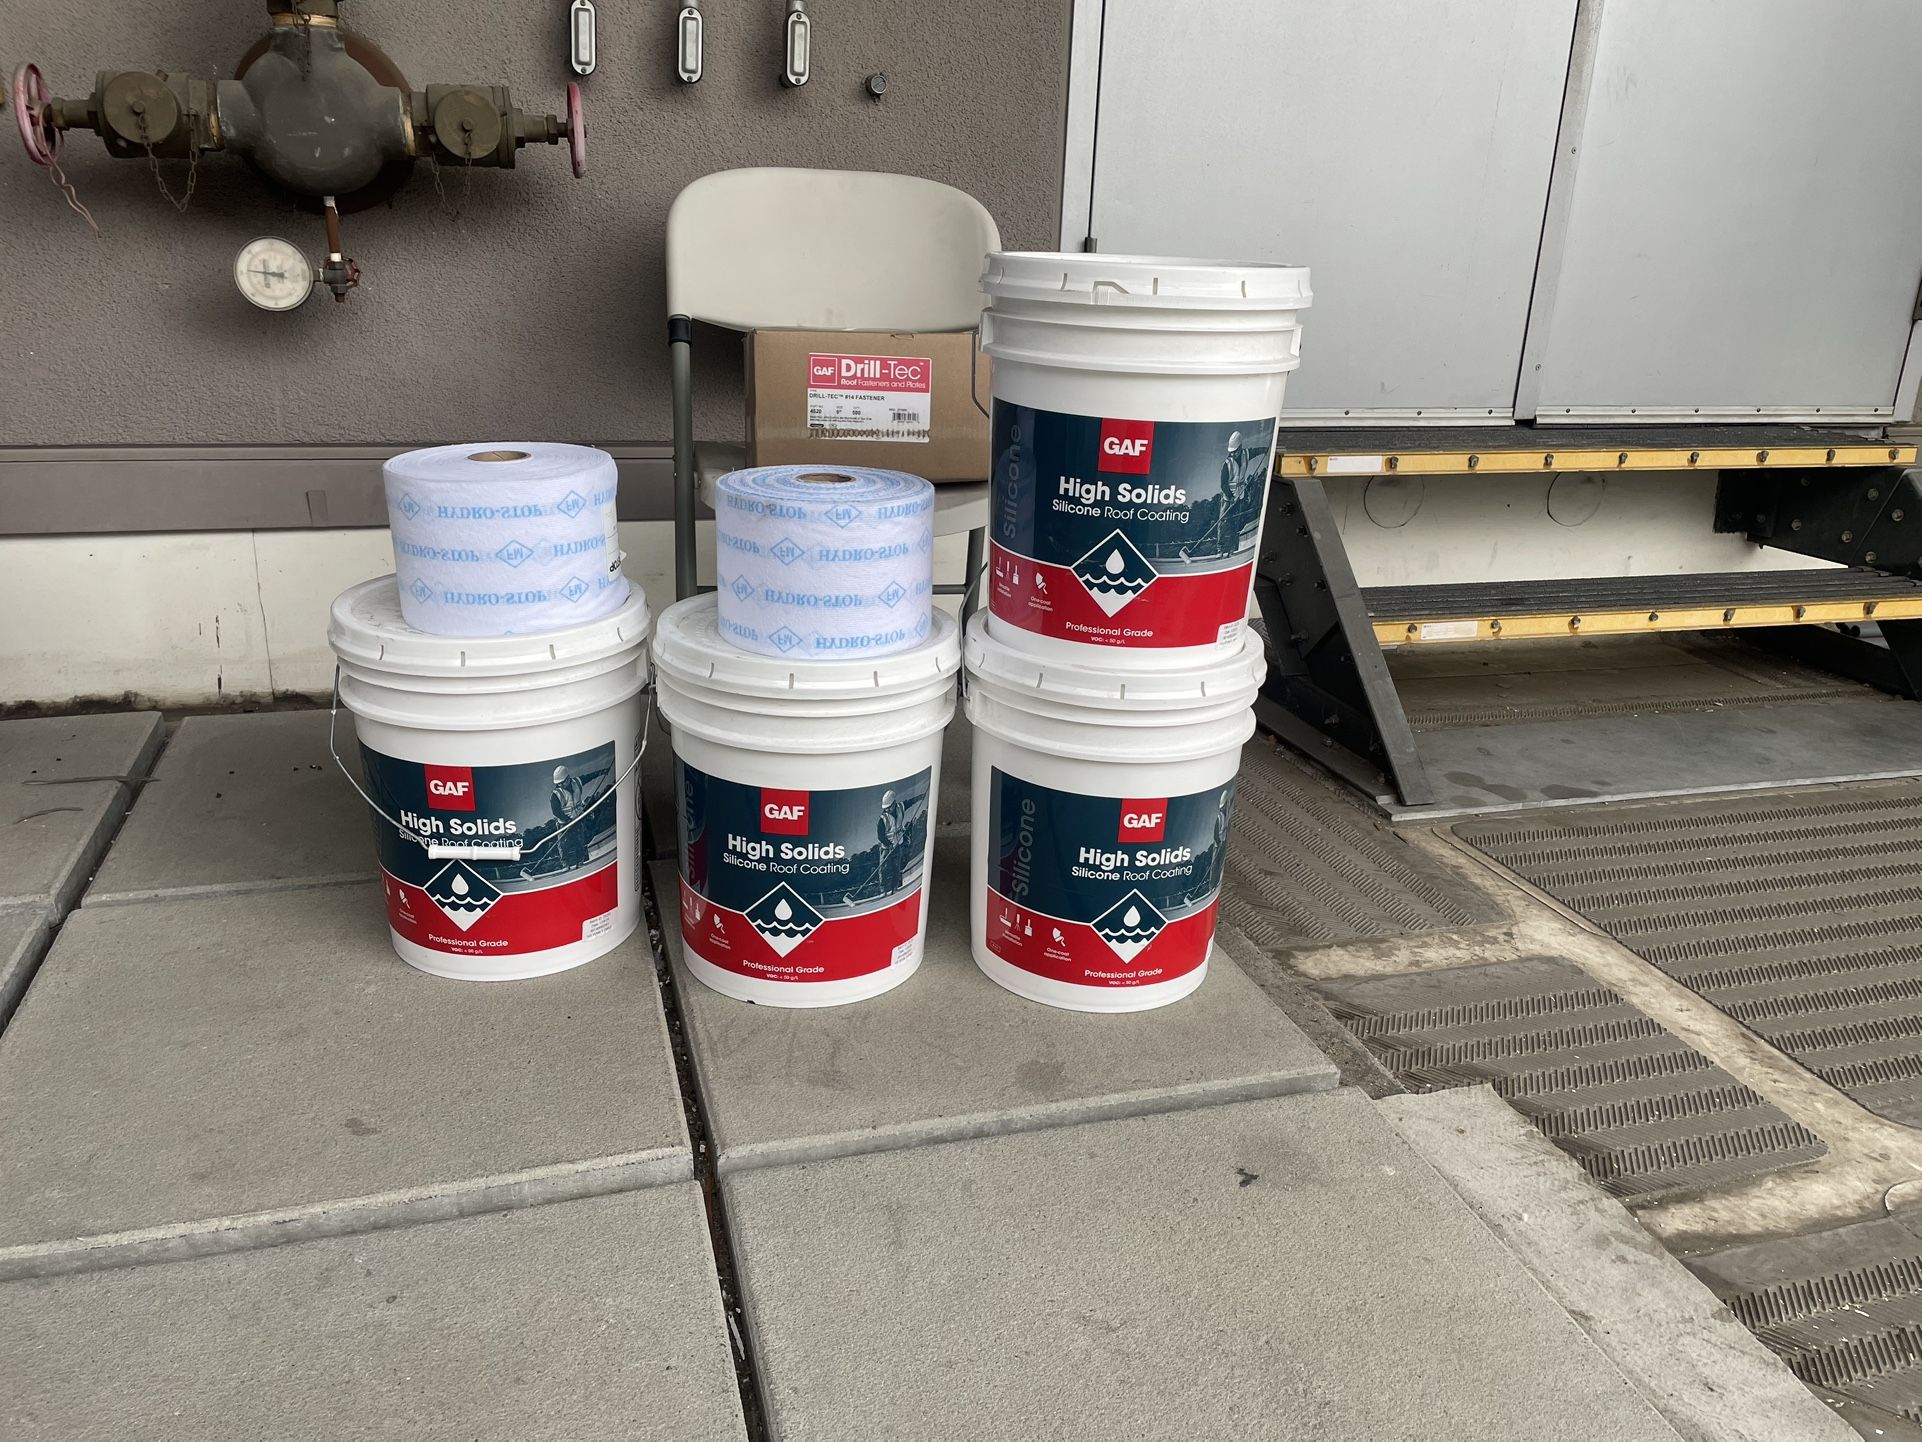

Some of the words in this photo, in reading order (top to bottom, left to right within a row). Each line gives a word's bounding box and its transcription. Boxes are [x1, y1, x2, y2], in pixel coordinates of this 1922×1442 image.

[814, 366, 835, 376] GAF
[1103, 436, 1148, 456] GAF
[1003, 424, 1022, 539] Silicone
[1058, 475, 1110, 505] High
[1116, 482, 1187, 505] Solids
[1052, 499, 1101, 517] Silicone
[1104, 506, 1135, 520] Roof
[1137, 508, 1190, 523] Coating
[1065, 621, 1121, 636] Professional
[1123, 628, 1154, 637] Grade
[429, 779, 469, 796] GAF
[764, 803, 805, 821] GAF
[1123, 812, 1163, 828] GAF
[400, 810, 444, 835] High
[449, 817, 517, 836] Solids
[727, 833, 774, 861] High
[780, 842, 846, 860] Solids
[1012, 798, 1036, 896] Silicone
[723, 852, 767, 872] Silicone
[769, 860, 798, 874] Roof
[800, 861, 850, 875] Coating
[1079, 846, 1129, 870] High
[1135, 846, 1191, 867] Solids
[1071, 866, 1121, 881] Silicone
[1123, 867, 1150, 881] Roof
[1152, 864, 1193, 880] Coating
[428, 933, 477, 947] Professional
[479, 939, 509, 947] Grade
[743, 959, 793, 973] Professional
[1084, 969, 1136, 979] Professional
[1137, 968, 1163, 977] Grade
